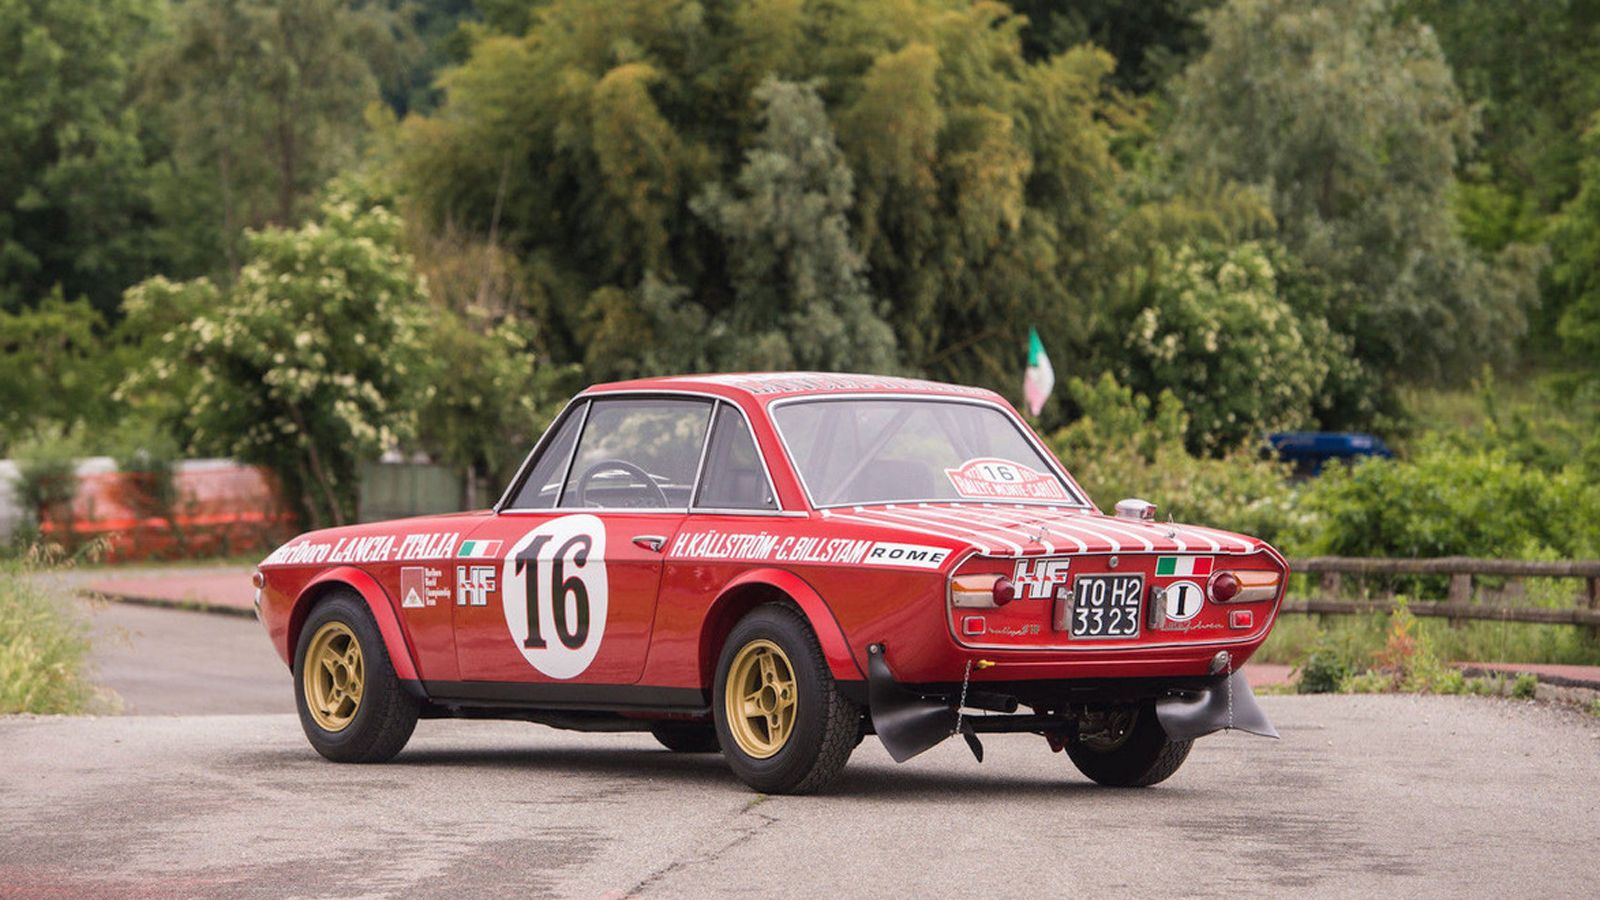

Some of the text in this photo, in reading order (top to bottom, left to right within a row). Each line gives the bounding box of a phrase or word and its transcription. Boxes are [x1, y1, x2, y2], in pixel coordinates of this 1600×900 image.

[984, 465, 1014, 481] 16
[327, 532, 460, 563] LANCIA-ITALIA
[870, 547, 947, 563] ROME
[457, 565, 496, 606] HF
[514, 533, 593, 650] 16
[1013, 558, 1071, 600] HF
[1079, 578, 1141, 606] TO H2
[1175, 586, 1188, 616] I
[1074, 609, 1102, 636] 33
[1108, 609, 1138, 636] 23
